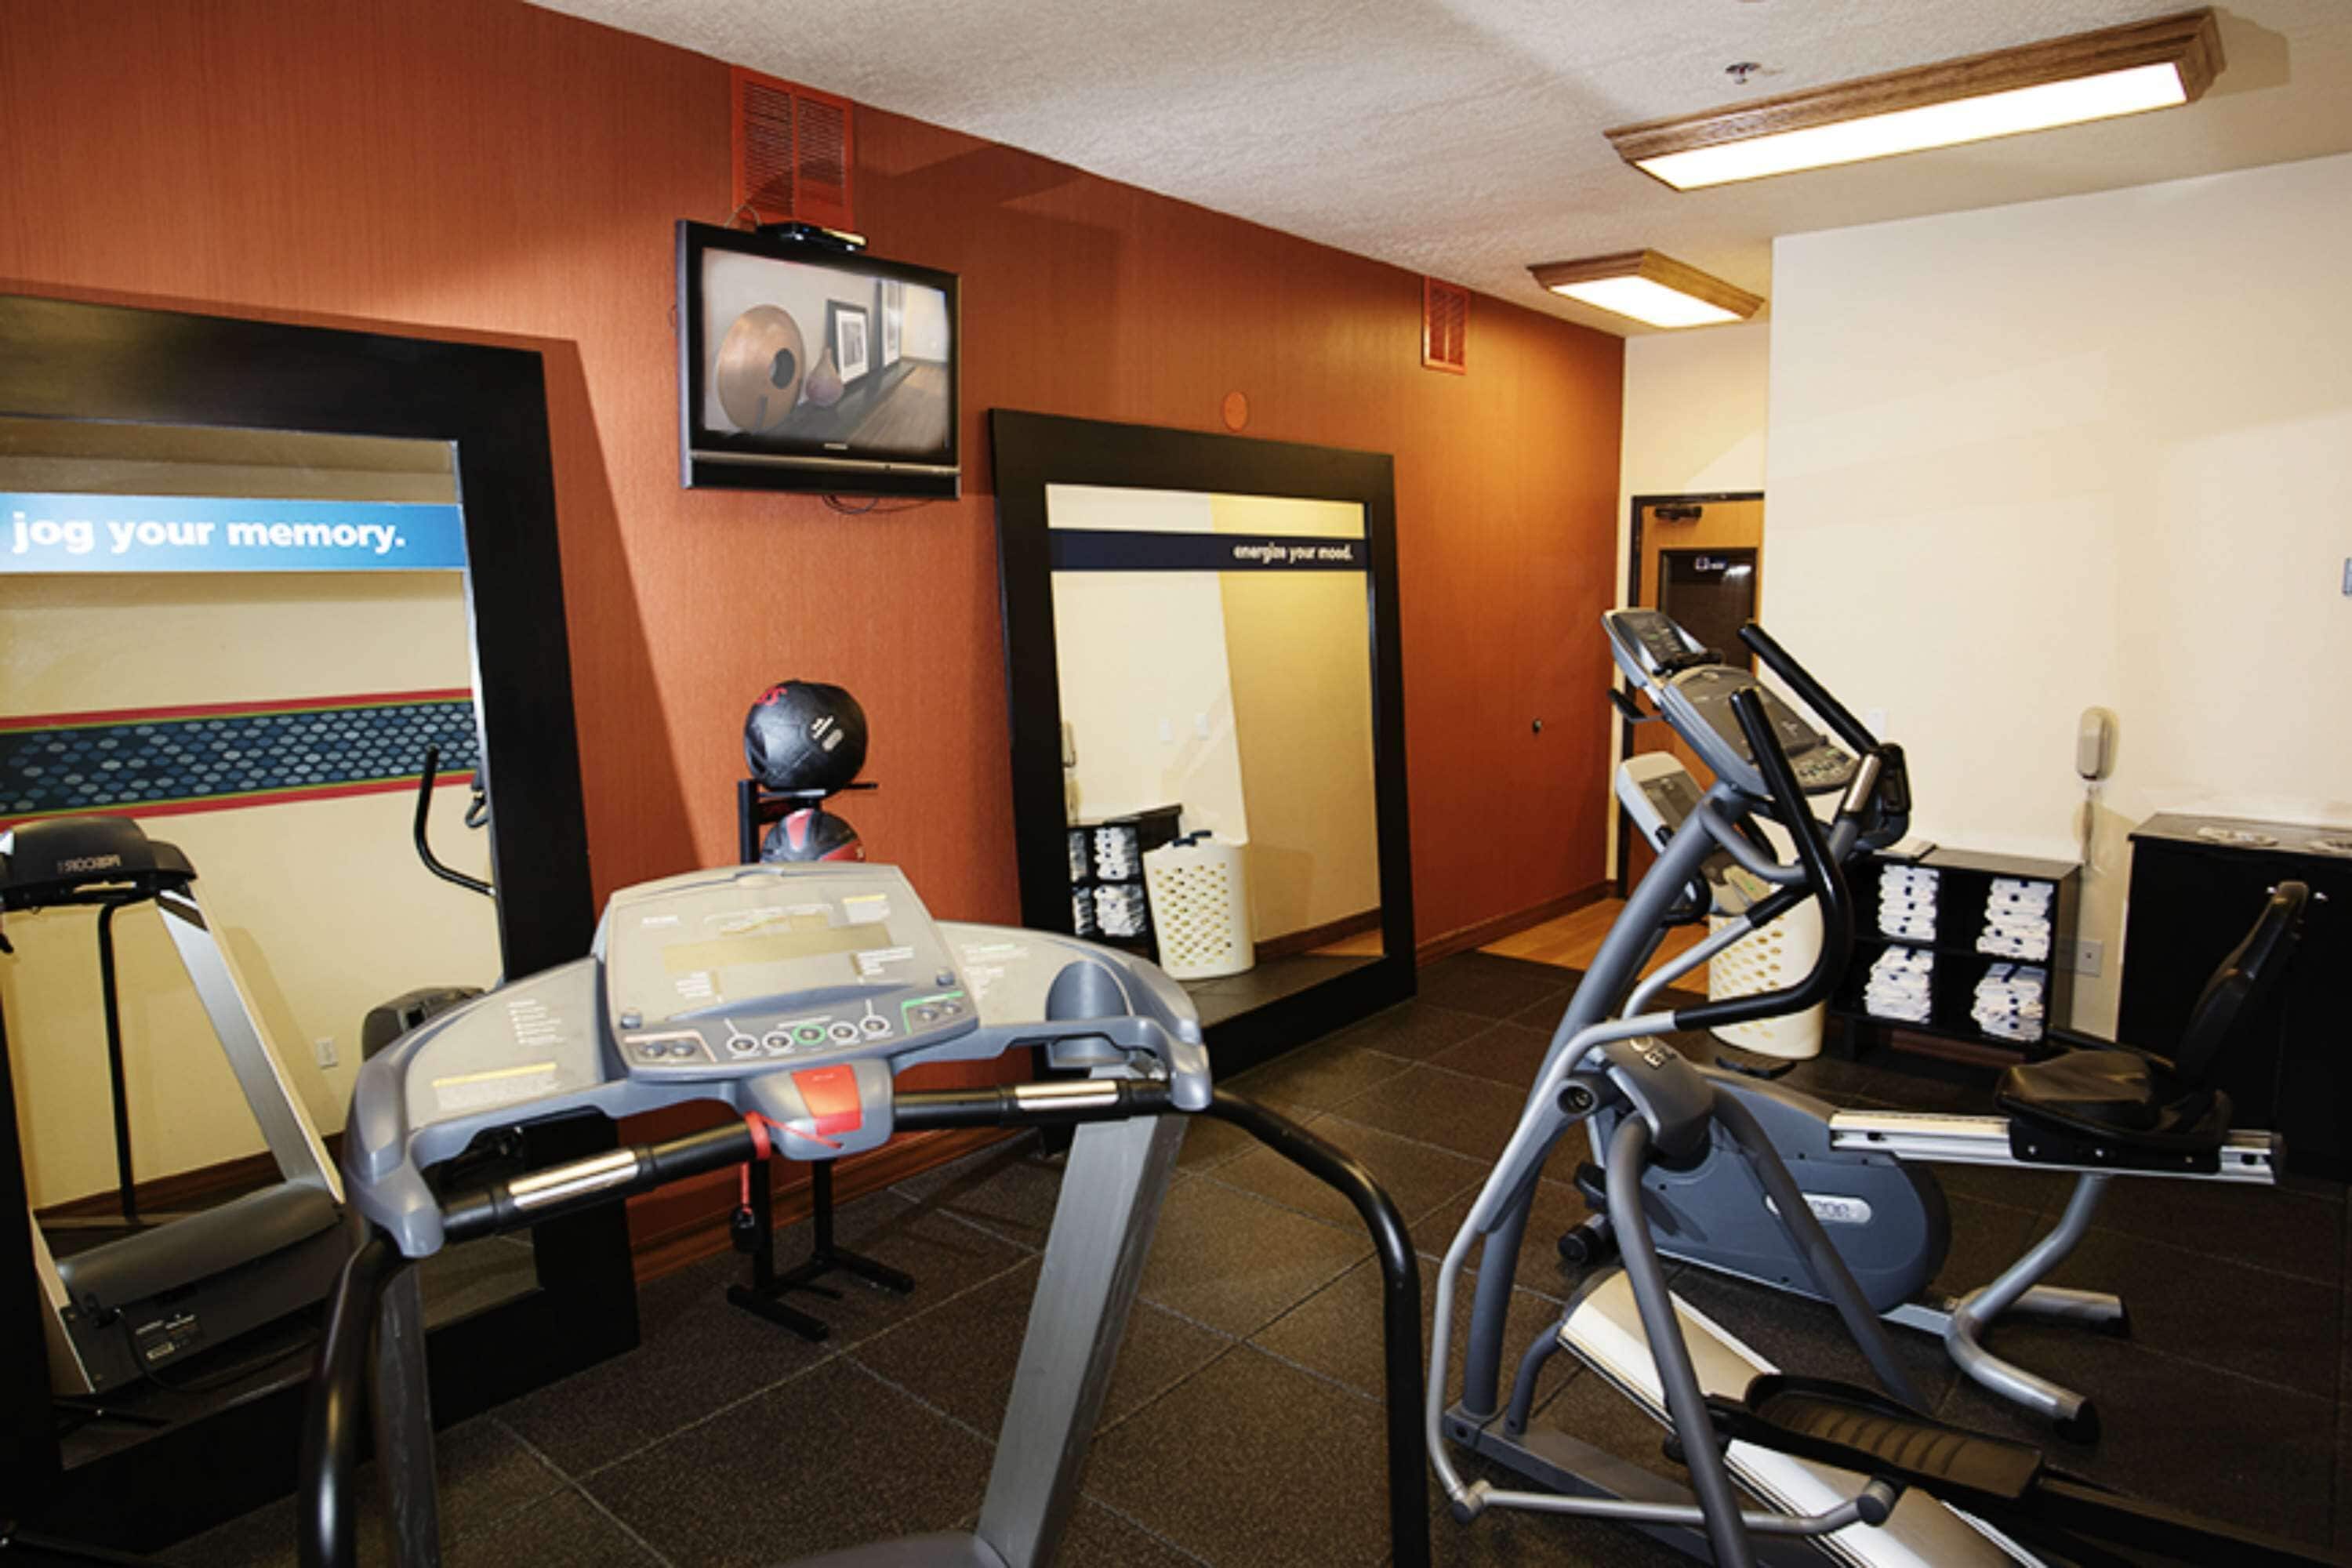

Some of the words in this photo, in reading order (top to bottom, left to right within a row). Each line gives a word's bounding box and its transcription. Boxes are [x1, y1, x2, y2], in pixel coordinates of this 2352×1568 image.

[13, 511, 95, 554] jog
[107, 522, 216, 554] your
[227, 522, 406, 555] memory.
[1289, 546, 1316, 564] your
